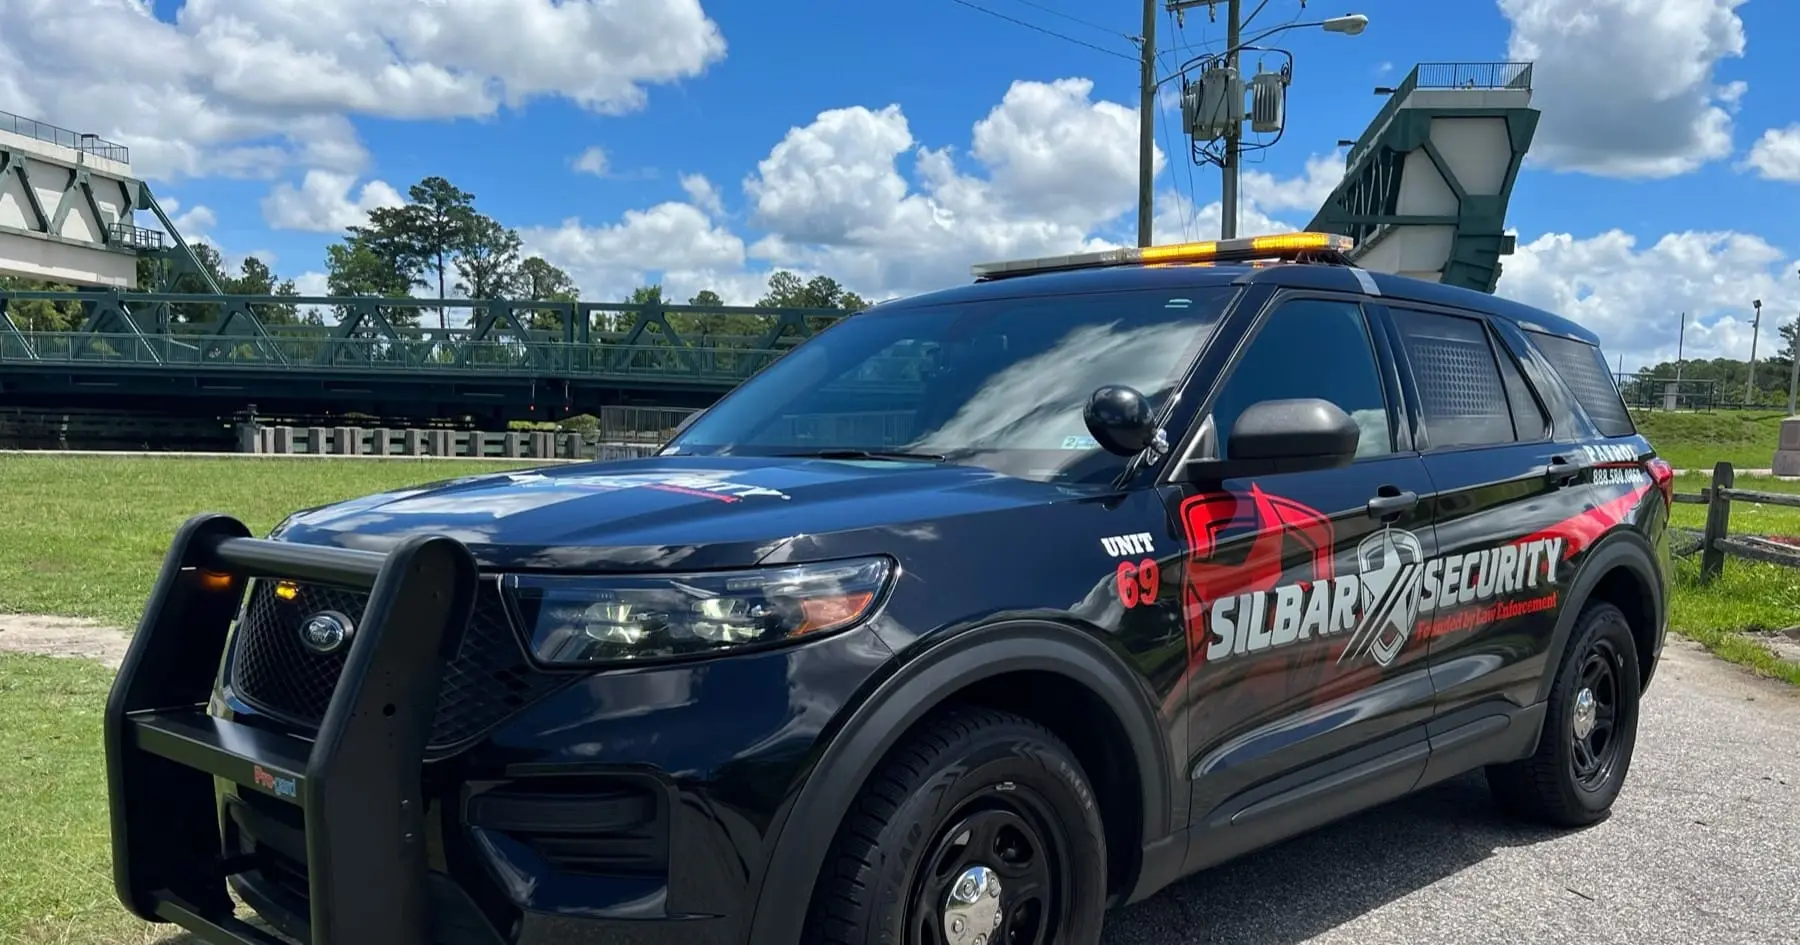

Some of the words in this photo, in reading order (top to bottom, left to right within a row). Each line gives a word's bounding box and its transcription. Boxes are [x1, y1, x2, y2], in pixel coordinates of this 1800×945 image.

[1583, 443, 1639, 462] PATROL
[1100, 532, 1155, 557] UNIT
[1117, 558, 1159, 608] 69
[1206, 574, 1361, 661] SILBAR
[1418, 536, 1562, 612] SECURITY
[1416, 612, 1462, 640] Founded
[1462, 611, 1477, 632] by
[1477, 605, 1498, 625] Law
[1497, 591, 1558, 620] Enforcement
